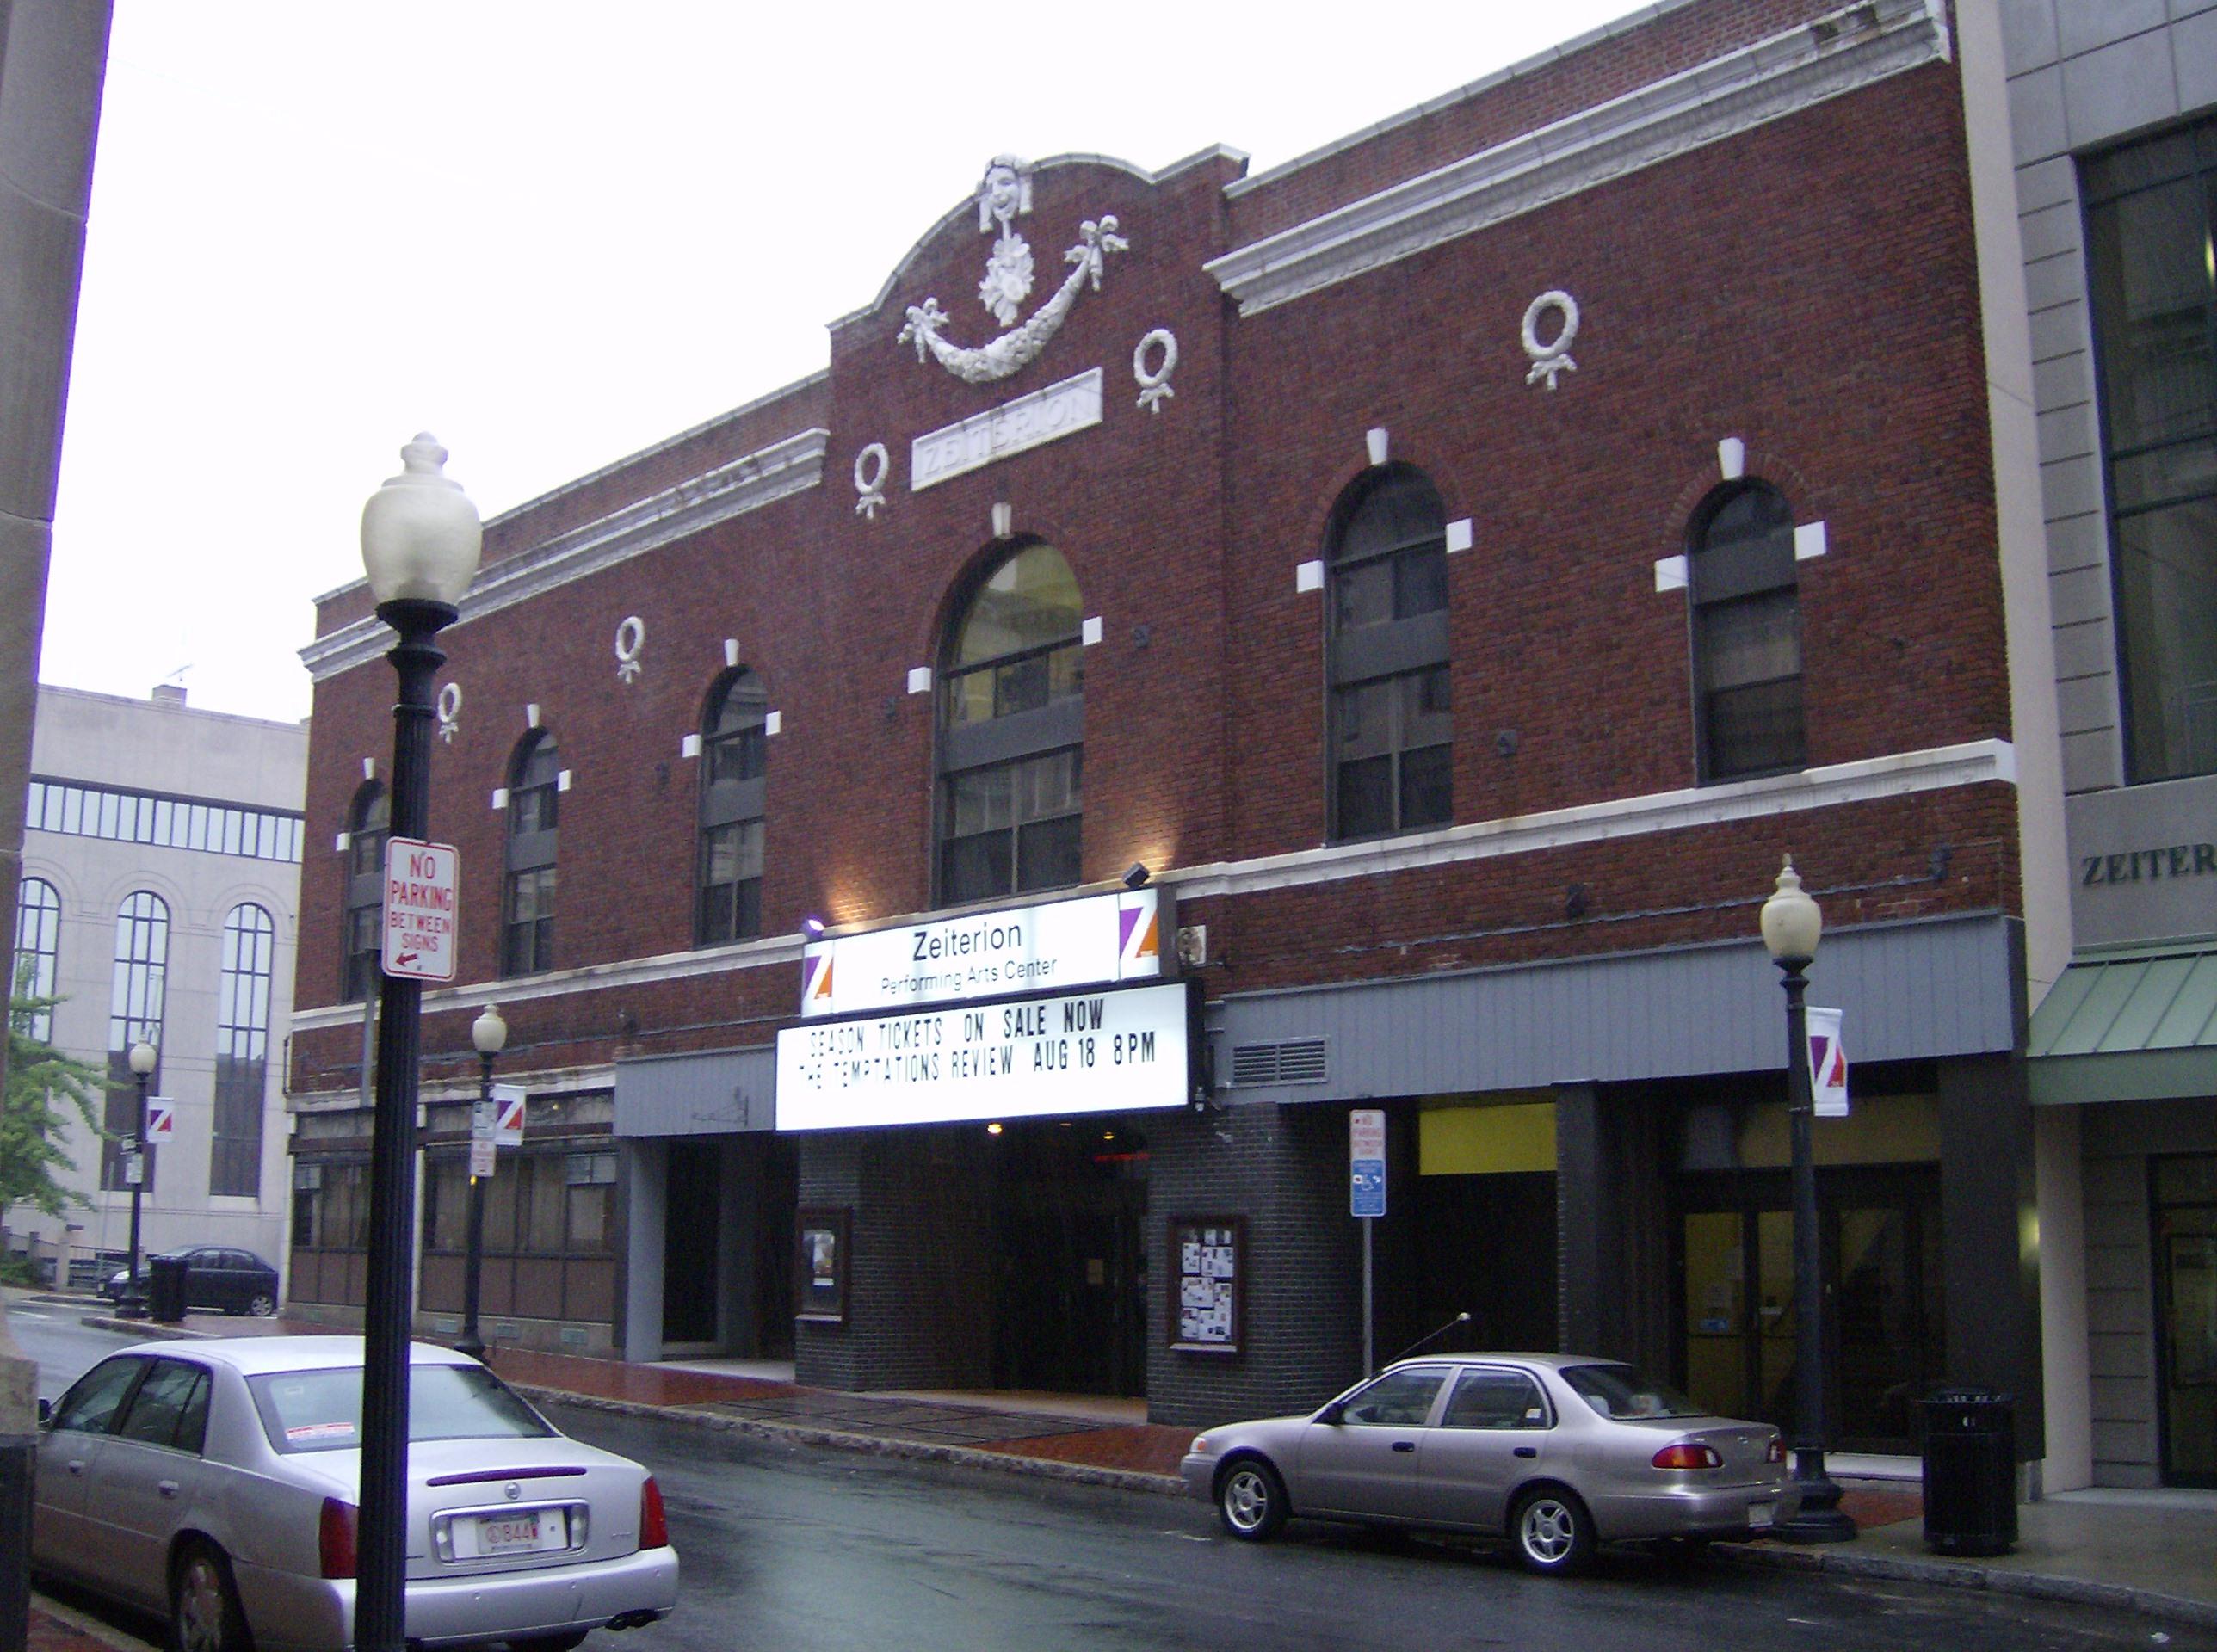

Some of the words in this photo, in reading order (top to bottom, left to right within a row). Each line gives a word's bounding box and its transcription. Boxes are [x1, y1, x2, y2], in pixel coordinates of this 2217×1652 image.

[923, 389, 1096, 475] ZEITERION
[409, 853, 436, 879] NO
[2082, 842, 2217, 885] ZEITER
[391, 880, 453, 912] PARKING
[390, 911, 452, 934] BETWEEN
[401, 932, 439, 952] SIGNS
[912, 922, 1022, 962] Zeiterion
[881, 971, 962, 994] Performing
[968, 965, 998, 984] Arts
[1004, 958, 1058, 980] Center
[810, 1026, 864, 1057] SEASON
[879, 1016, 942, 1050] TICKETS
[964, 1012, 985, 1043] ON
[1004, 1004, 1047, 1039] SALE
[1064, 998, 1104, 1033] NOW
[832, 1051, 940, 1088] TEMPTATIONS
[952, 1044, 1014, 1078] REVIEW
[1034, 1039, 1068, 1072] AUG
[1078, 1036, 1096, 1069] 18
